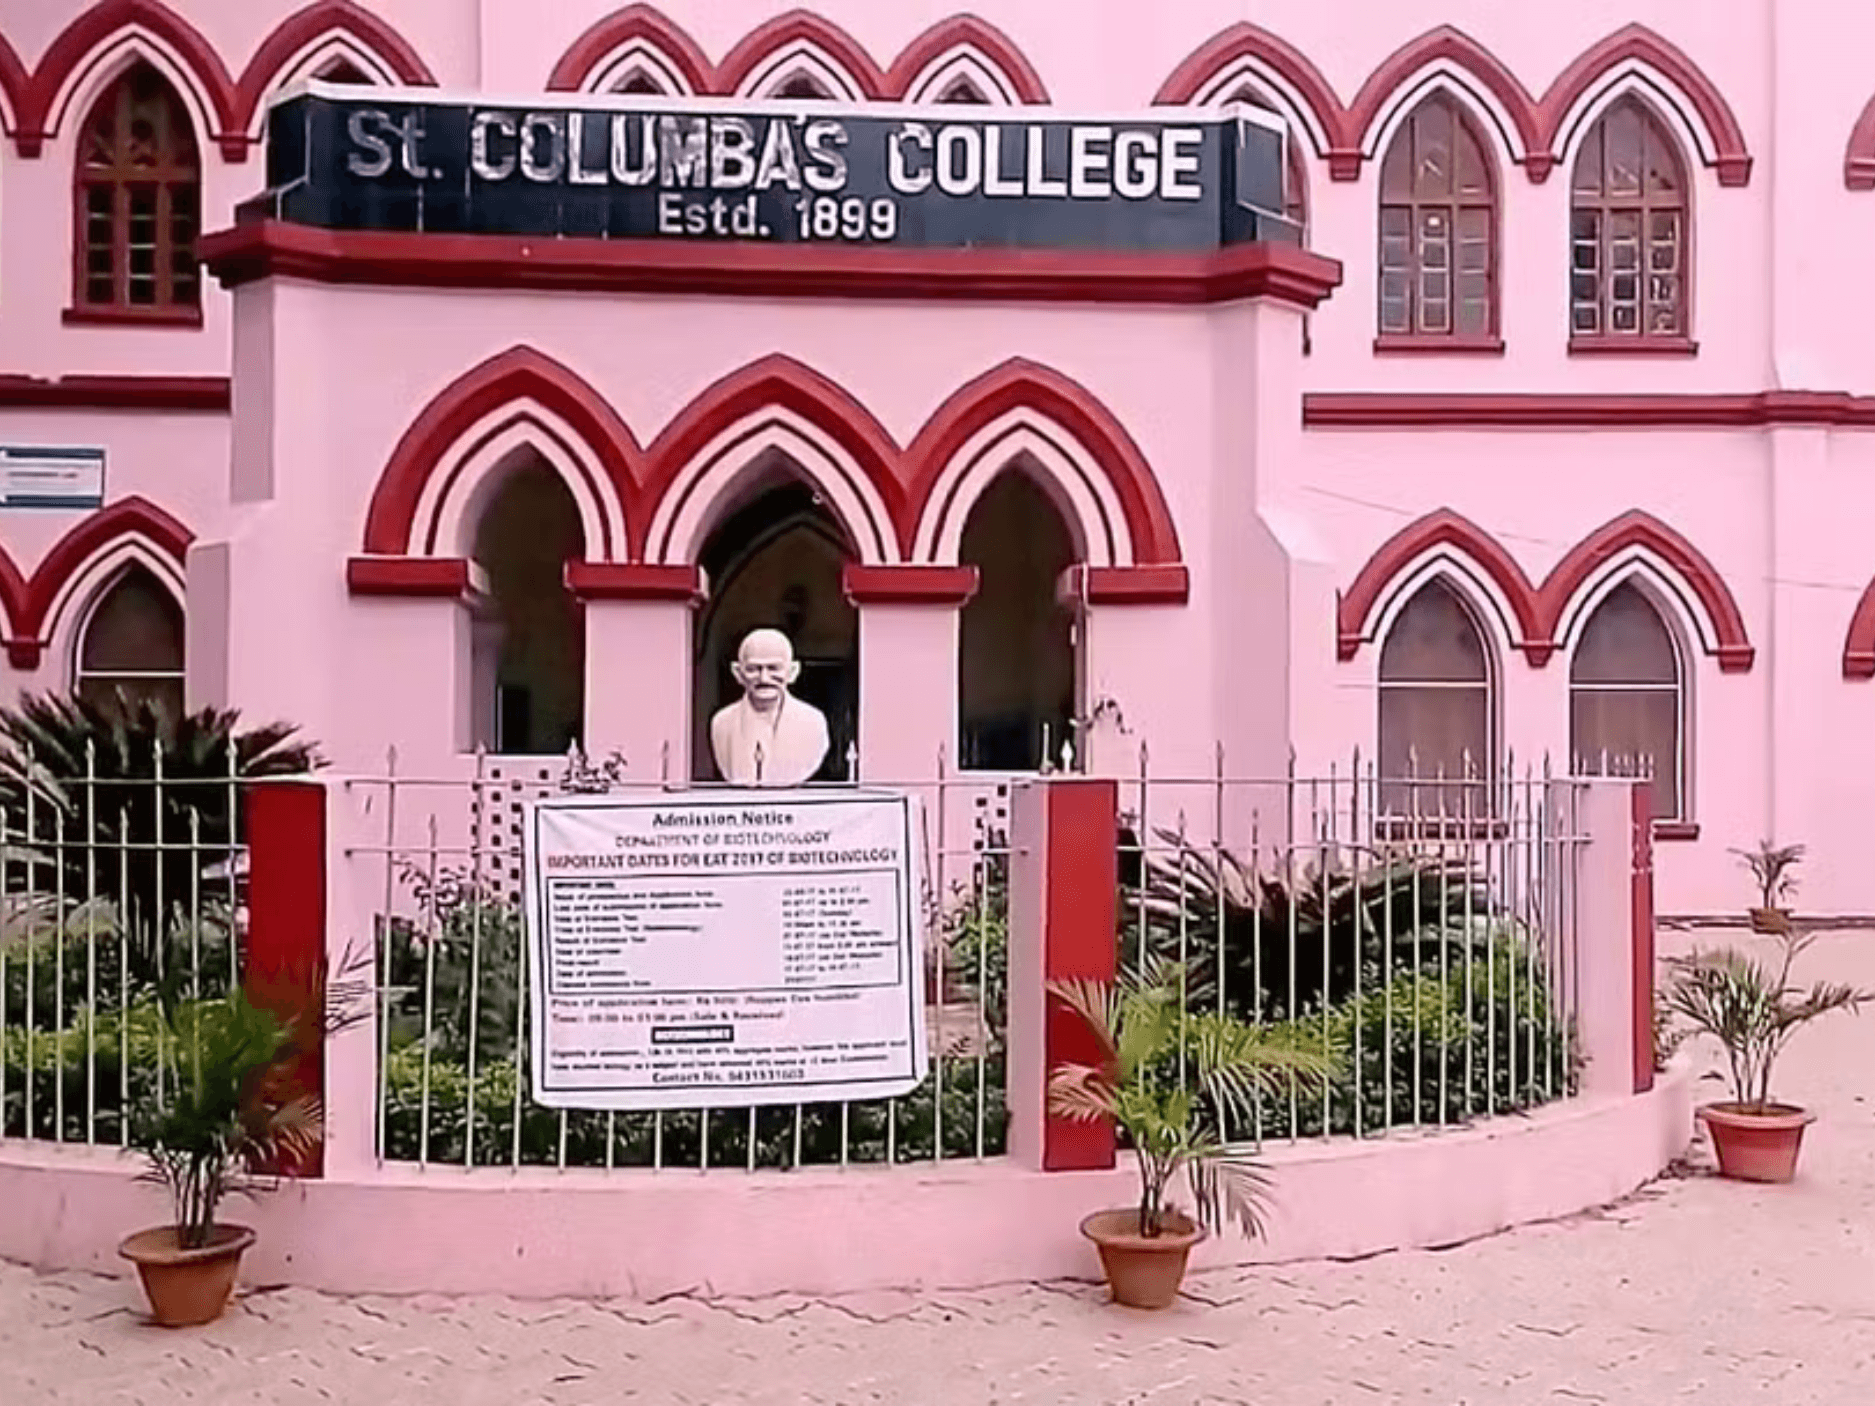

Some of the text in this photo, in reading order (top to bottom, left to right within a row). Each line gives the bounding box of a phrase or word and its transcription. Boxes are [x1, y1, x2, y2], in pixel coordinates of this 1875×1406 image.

[347, 110, 444, 178] St.
[888, 122, 1202, 201] COLLEGE
[658, 192, 898, 241] Estd. 1899
[652, 810, 794, 827] Admission Notice
[547, 854, 624, 869] IMPORTANT
[627, 853, 670, 868] DATES
[673, 852, 700, 867] FOR
[766, 850, 784, 865] OF
[788, 847, 898, 865] BIOTECHNOLOGY
[652, 1071, 700, 1083] Contact
